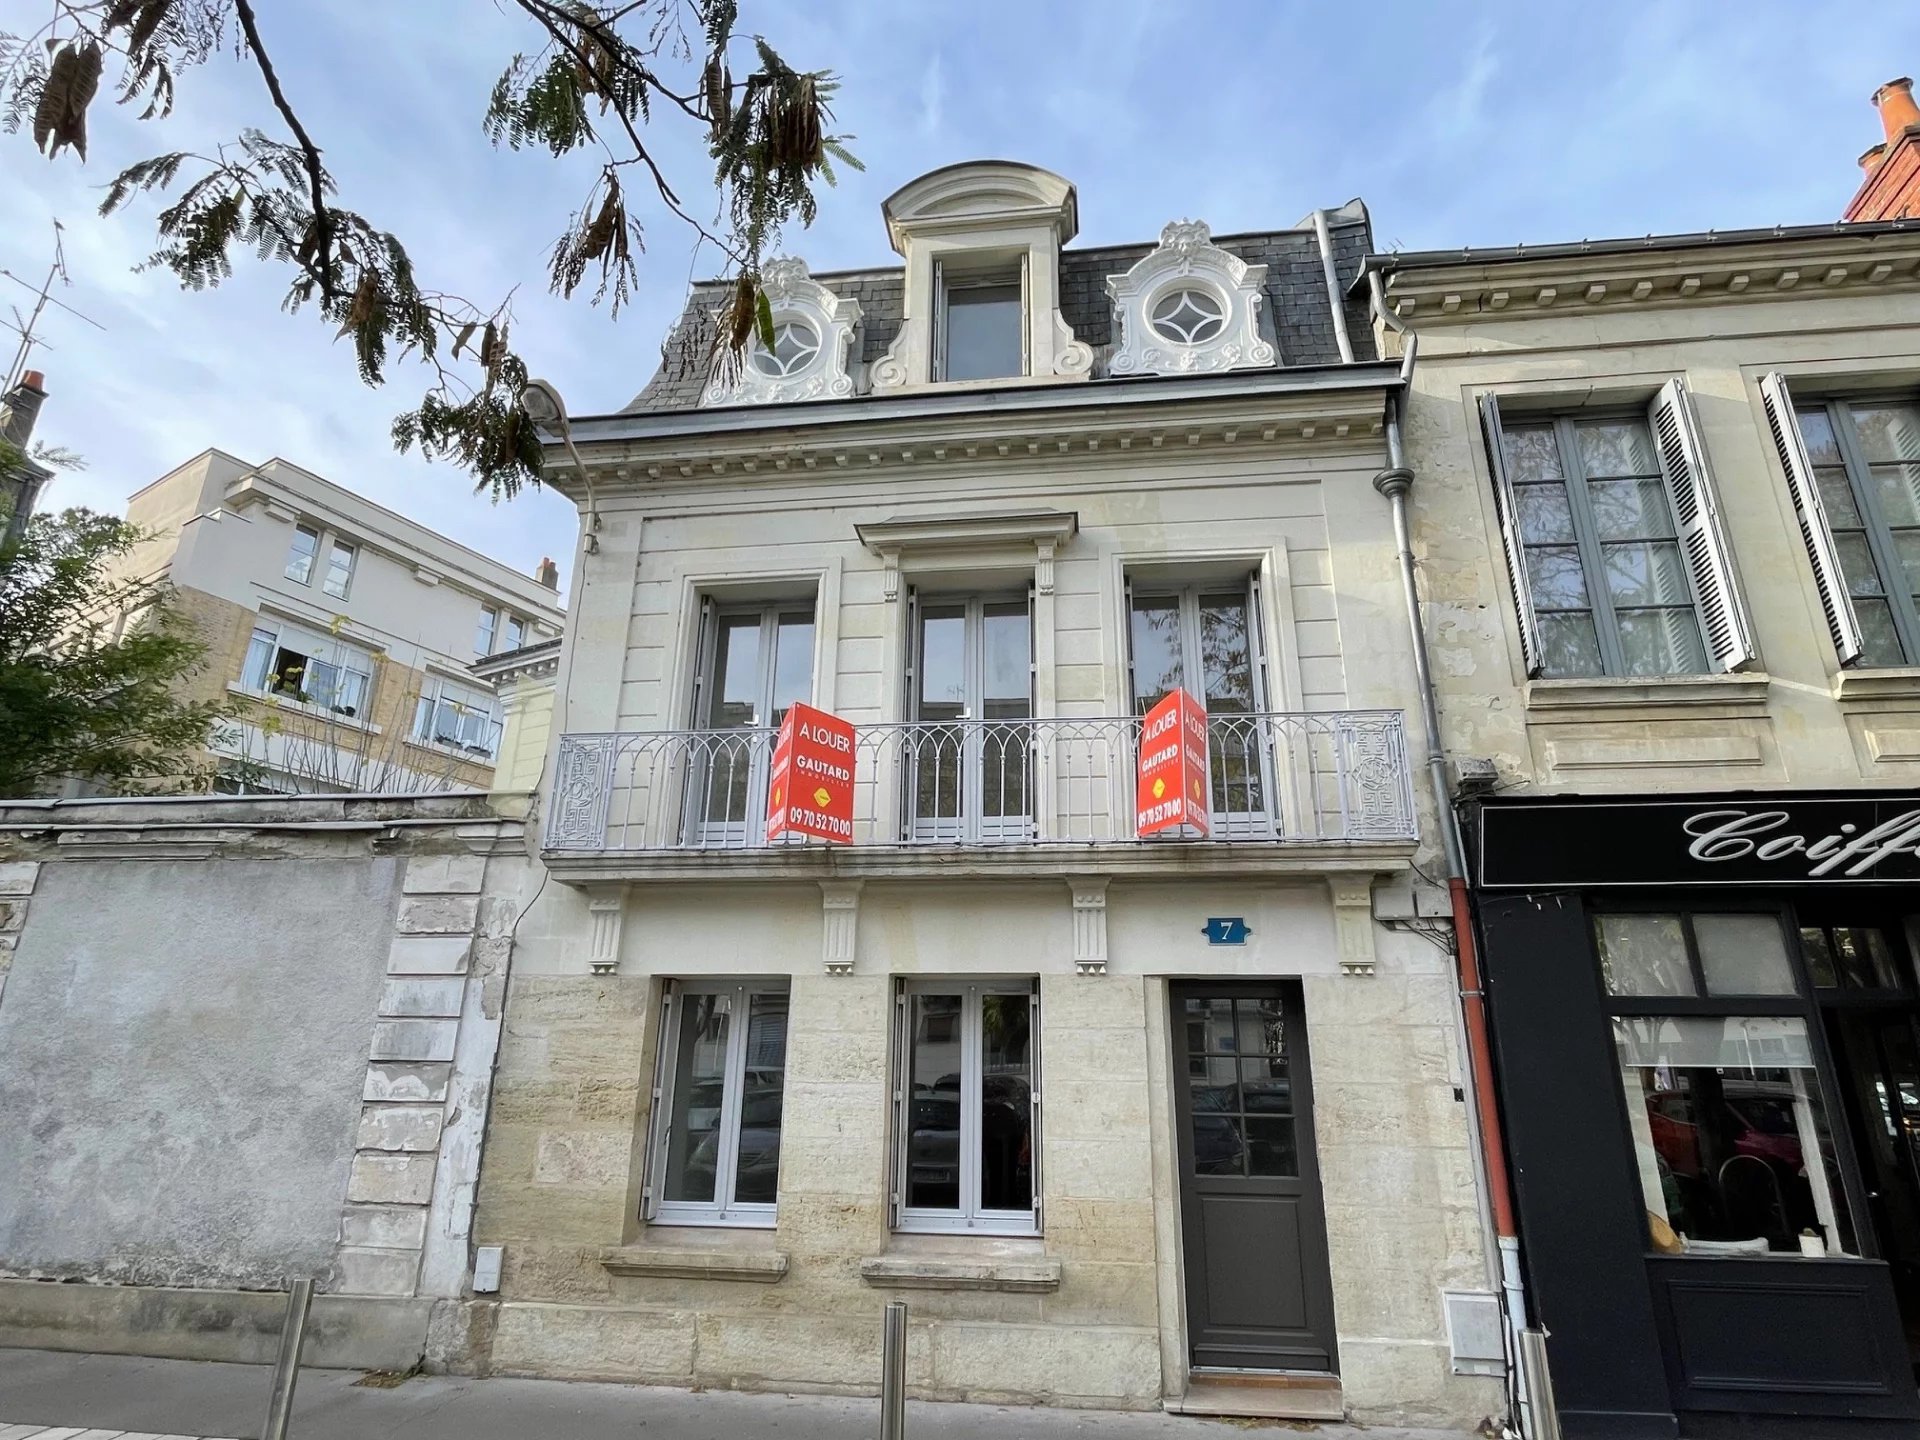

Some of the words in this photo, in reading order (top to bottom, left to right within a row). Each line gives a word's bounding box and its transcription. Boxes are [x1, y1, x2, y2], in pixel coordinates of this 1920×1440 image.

[799, 722, 810, 740] A
[812, 725, 850, 753] LOUER
[1144, 727, 1151, 744] A
[1151, 709, 1177, 739] LOUER
[796, 755, 850, 781] GAUTARD
[1142, 744, 1178, 772] GAUTARD
[790, 806, 803, 824] 09
[803, 809, 815, 827] 70
[815, 812, 827, 830] 52
[828, 816, 839, 833] 70
[839, 819, 851, 836] 00
[1683, 809, 1920, 876] Coiff
[1220, 921, 1233, 940] 7
